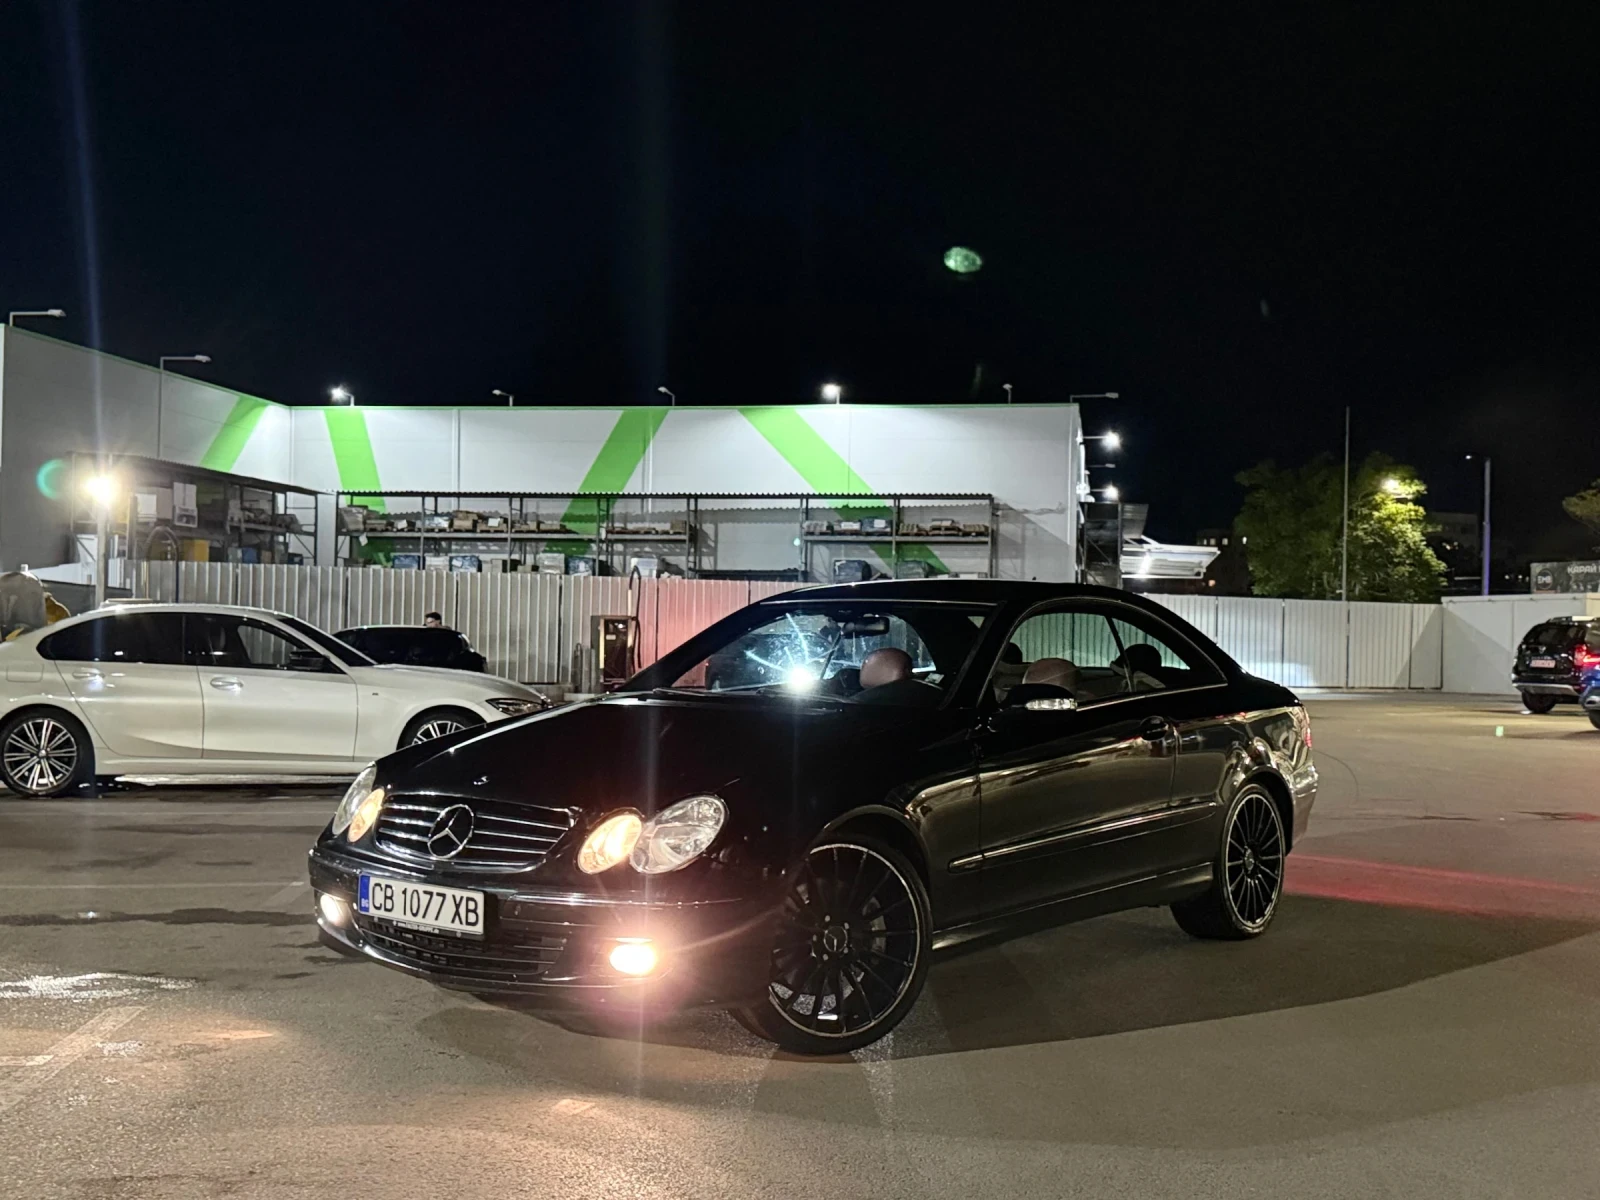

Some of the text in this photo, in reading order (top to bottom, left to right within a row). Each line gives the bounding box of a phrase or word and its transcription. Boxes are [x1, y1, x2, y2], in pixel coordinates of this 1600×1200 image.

[372, 882, 395, 912] CB
[402, 887, 447, 921] 1077
[451, 894, 480, 927] XB
